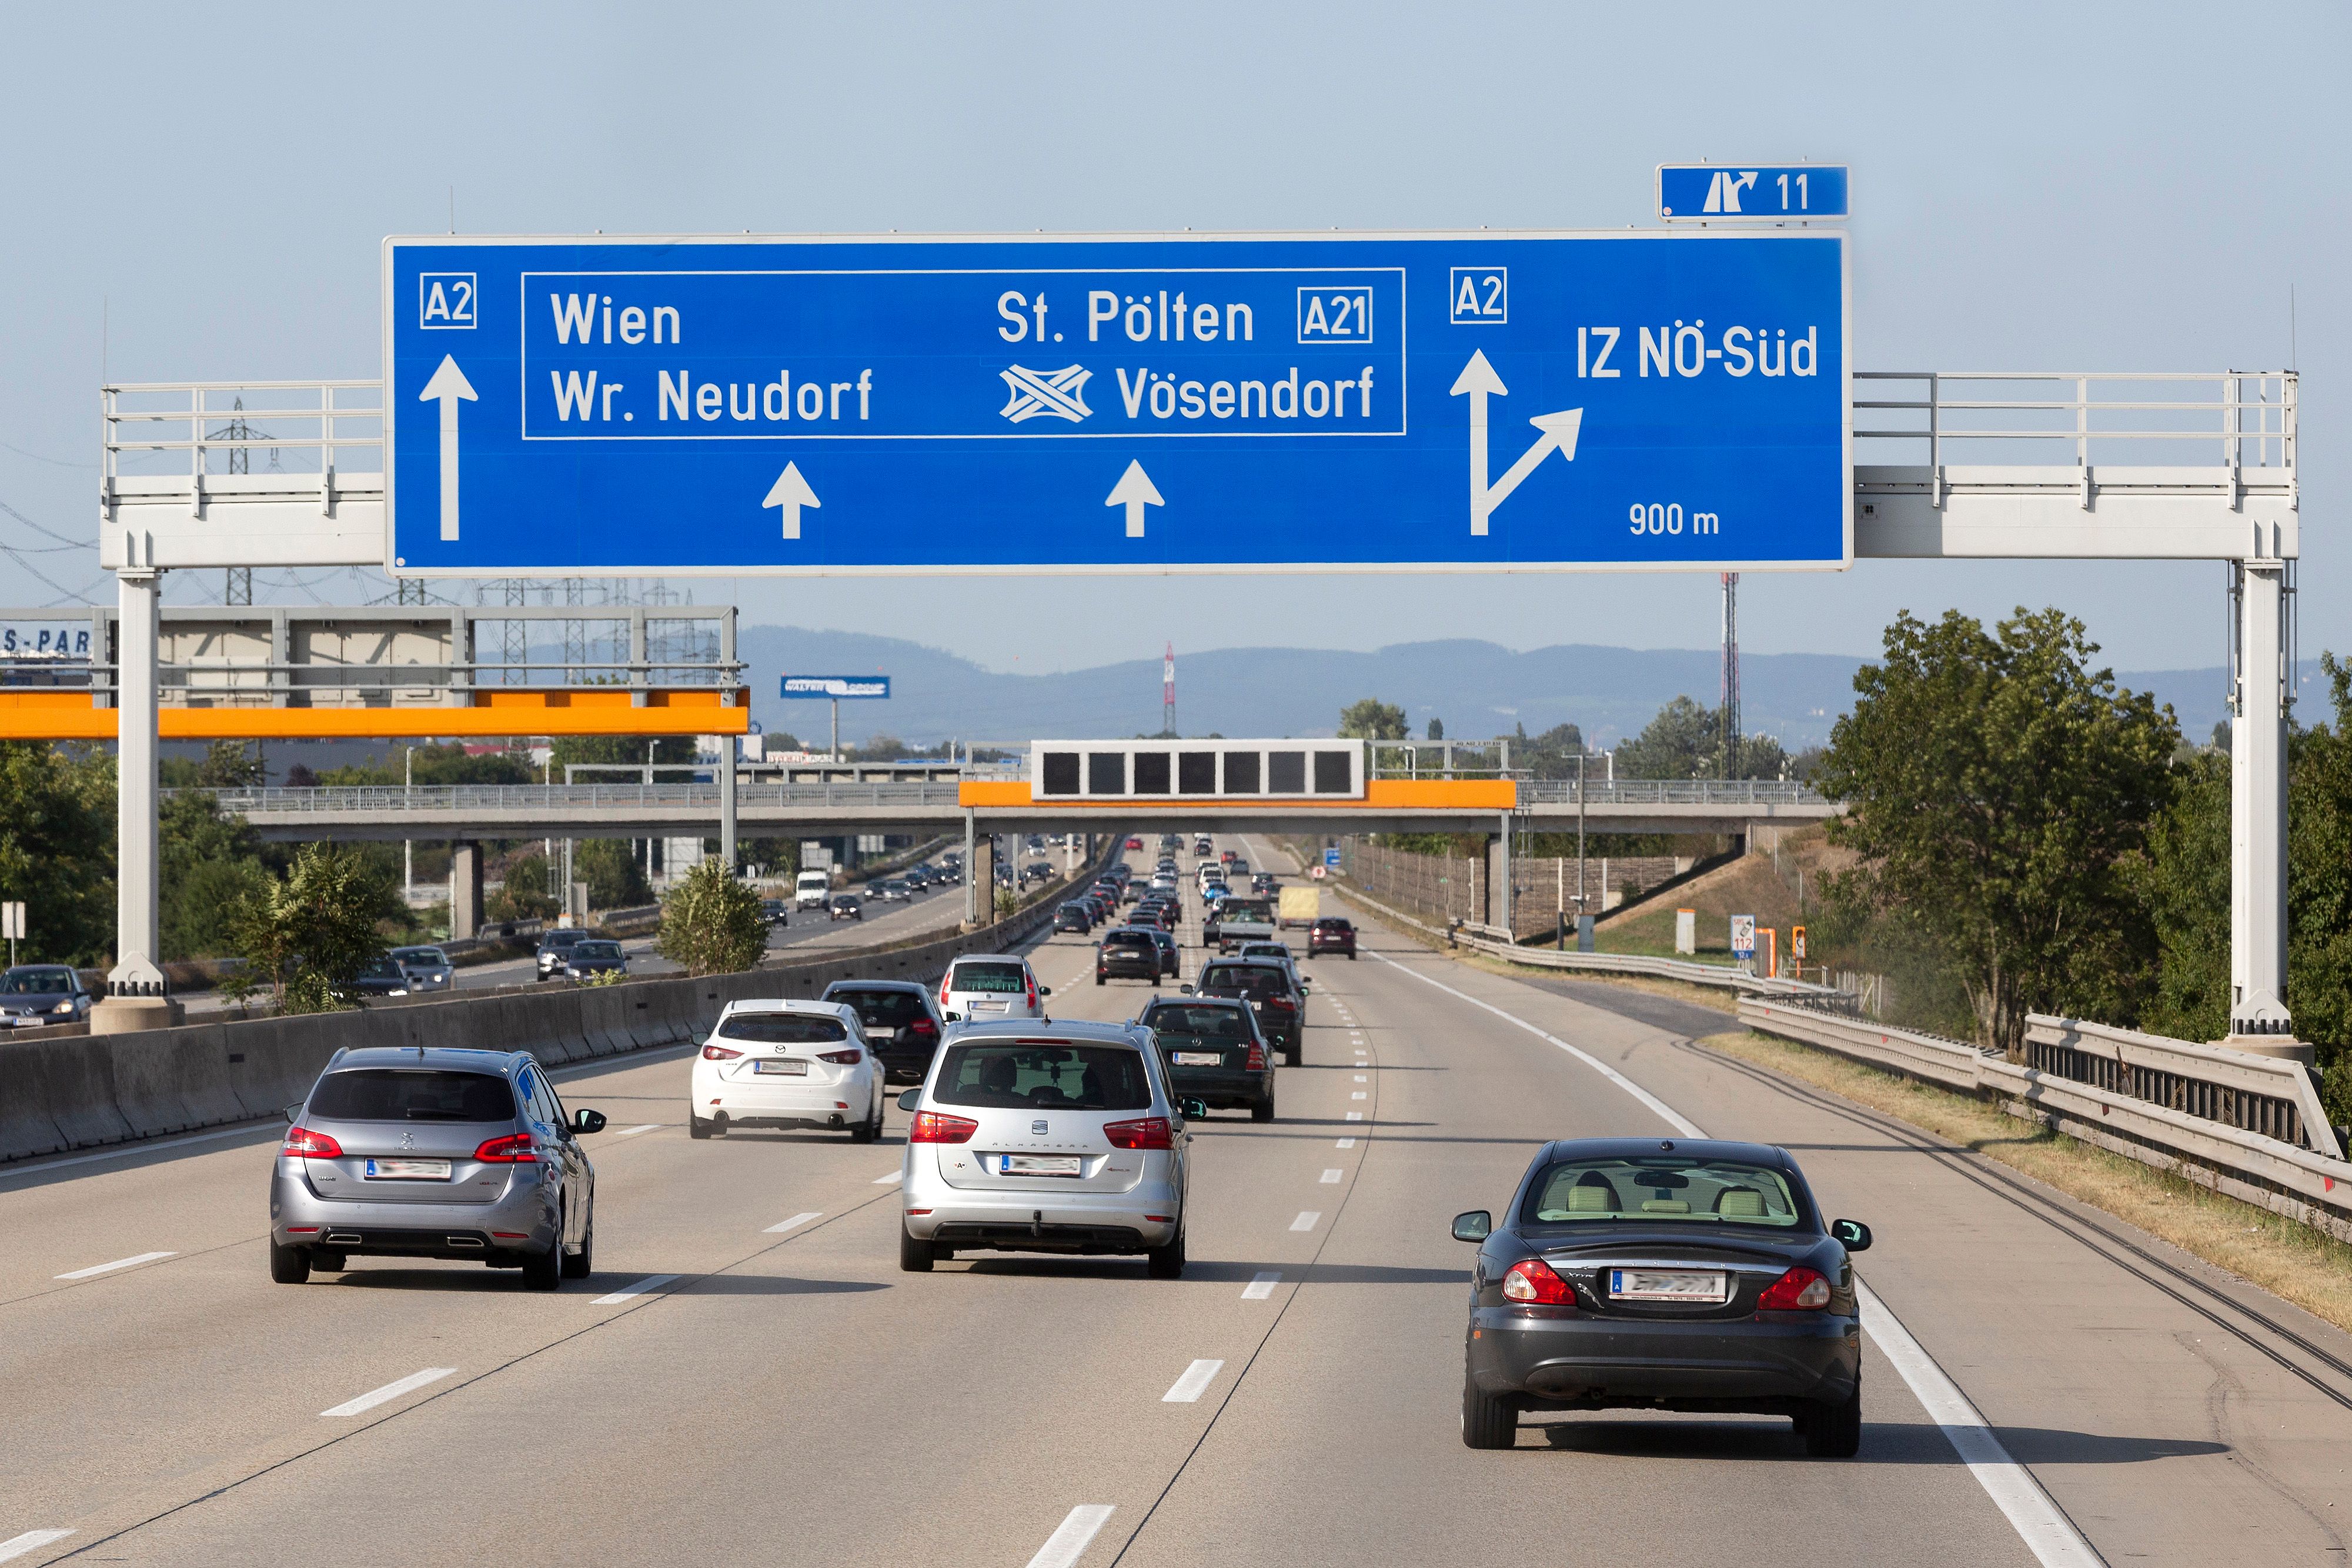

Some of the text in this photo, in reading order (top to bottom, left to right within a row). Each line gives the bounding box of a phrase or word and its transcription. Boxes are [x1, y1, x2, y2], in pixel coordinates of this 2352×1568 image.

[1777, 174, 1808, 210] 11
[425, 282, 473, 320] A2
[1455, 276, 1502, 315] A2
[550, 293, 680, 345] Wien
[997, 290, 1253, 343] St. Pölten
[1304, 296, 1365, 335] A21
[1578, 319, 1818, 378] IZ NÖ-Süd
[551, 369, 872, 422] Wr. Neudorf
[1116, 366, 1374, 419] Vösendorf
[1629, 503, 1719, 535] 900 m
[1735, 938, 1752, 950] 112
